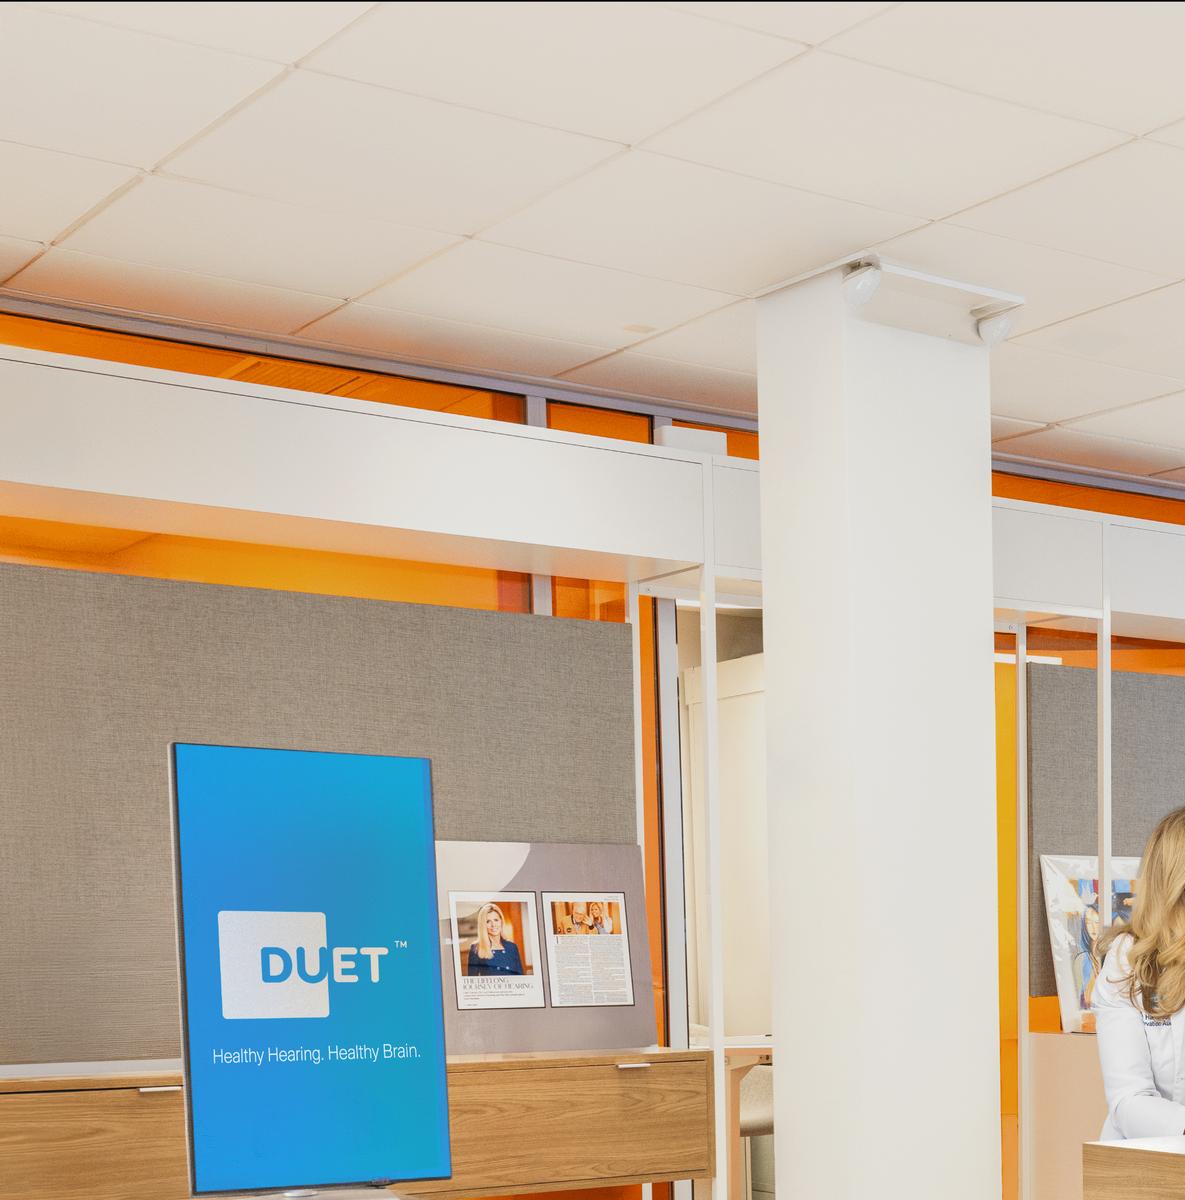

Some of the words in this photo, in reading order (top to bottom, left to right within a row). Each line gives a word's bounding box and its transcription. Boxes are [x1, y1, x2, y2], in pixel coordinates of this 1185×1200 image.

[260, 946, 389, 984] DUET
[463, 977, 475, 985] THE
[213, 1048, 264, 1066] Healthy
[267, 1046, 324, 1064] Hearing.
[328, 1043, 379, 1062] Healthy
[383, 1042, 421, 1059] Brain.
